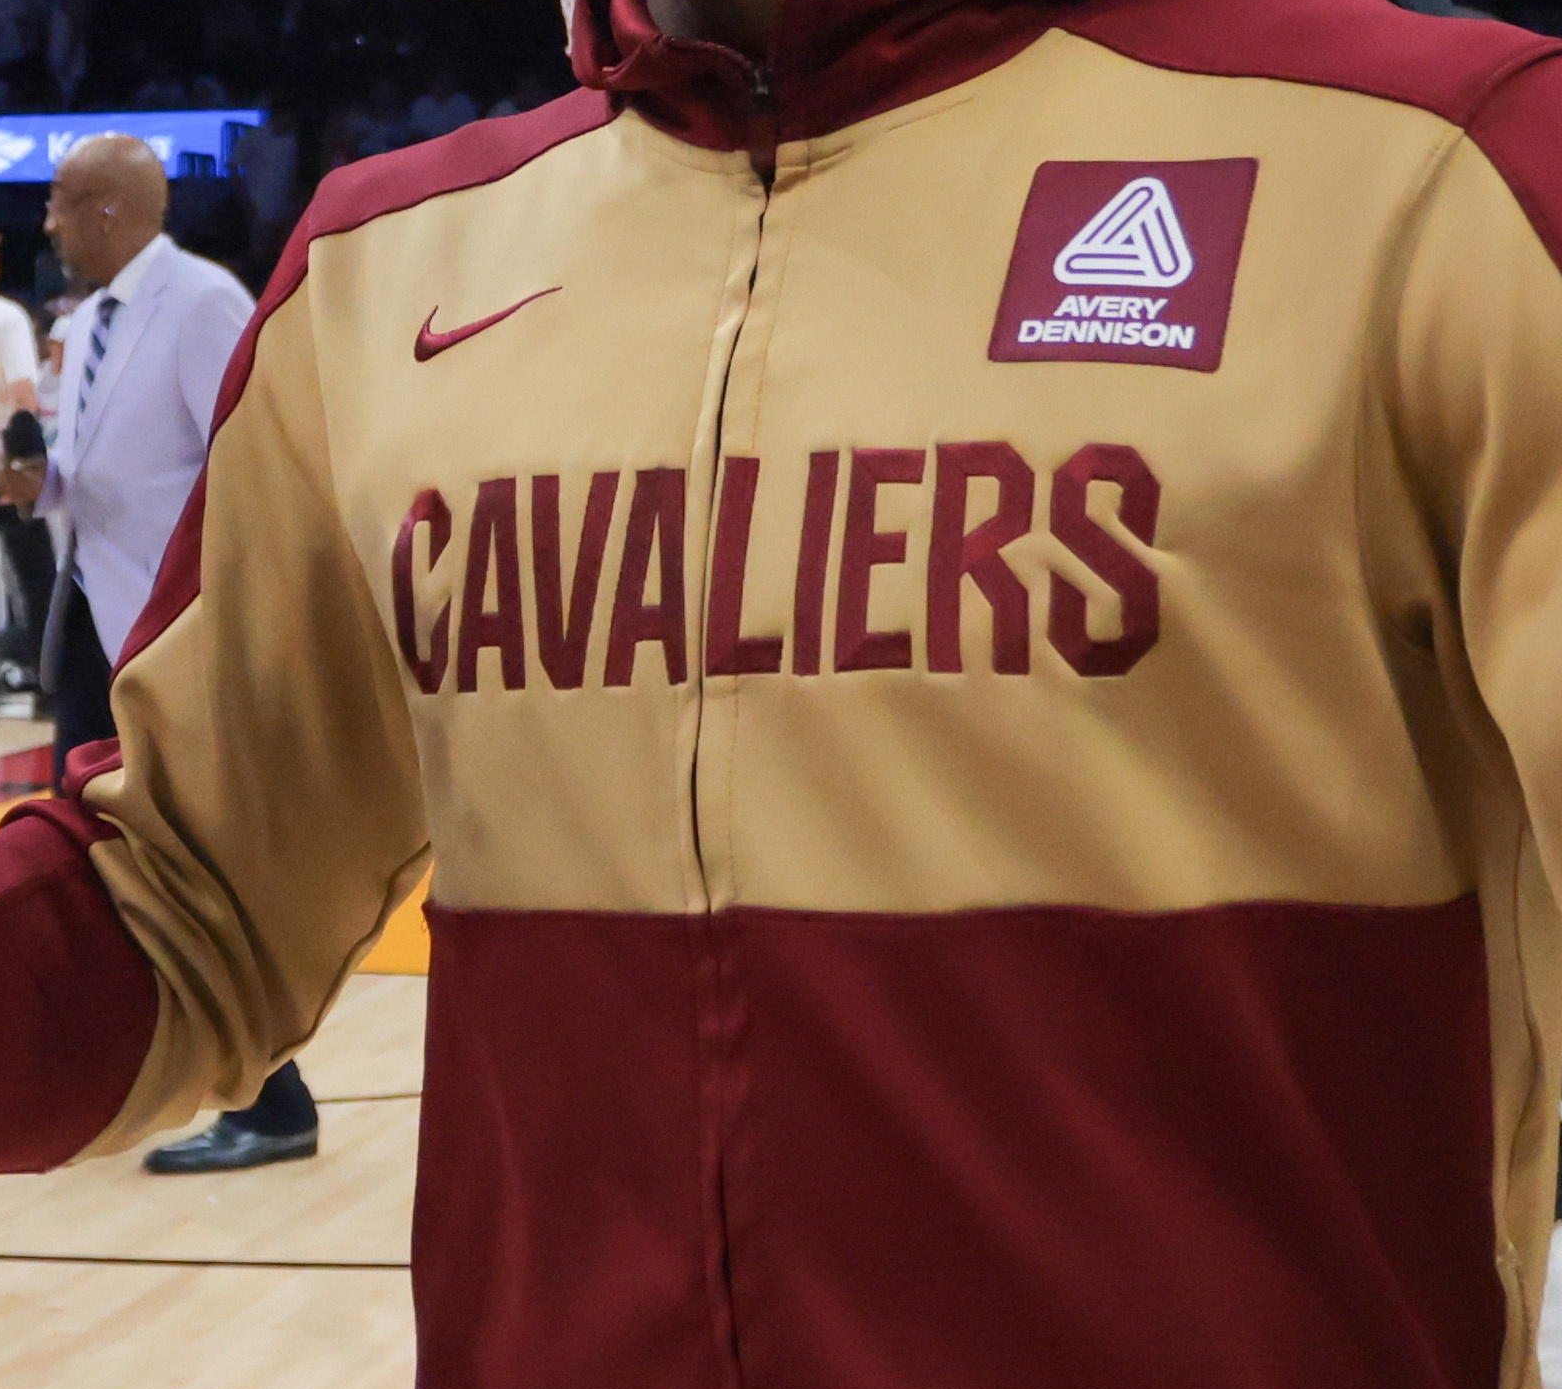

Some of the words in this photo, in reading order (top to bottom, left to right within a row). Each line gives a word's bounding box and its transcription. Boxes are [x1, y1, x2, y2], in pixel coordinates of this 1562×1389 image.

[1053, 294, 1169, 320] AVERY
[1017, 319, 1196, 350] DENNISON
[392, 441, 1161, 696] CAVALIERS
